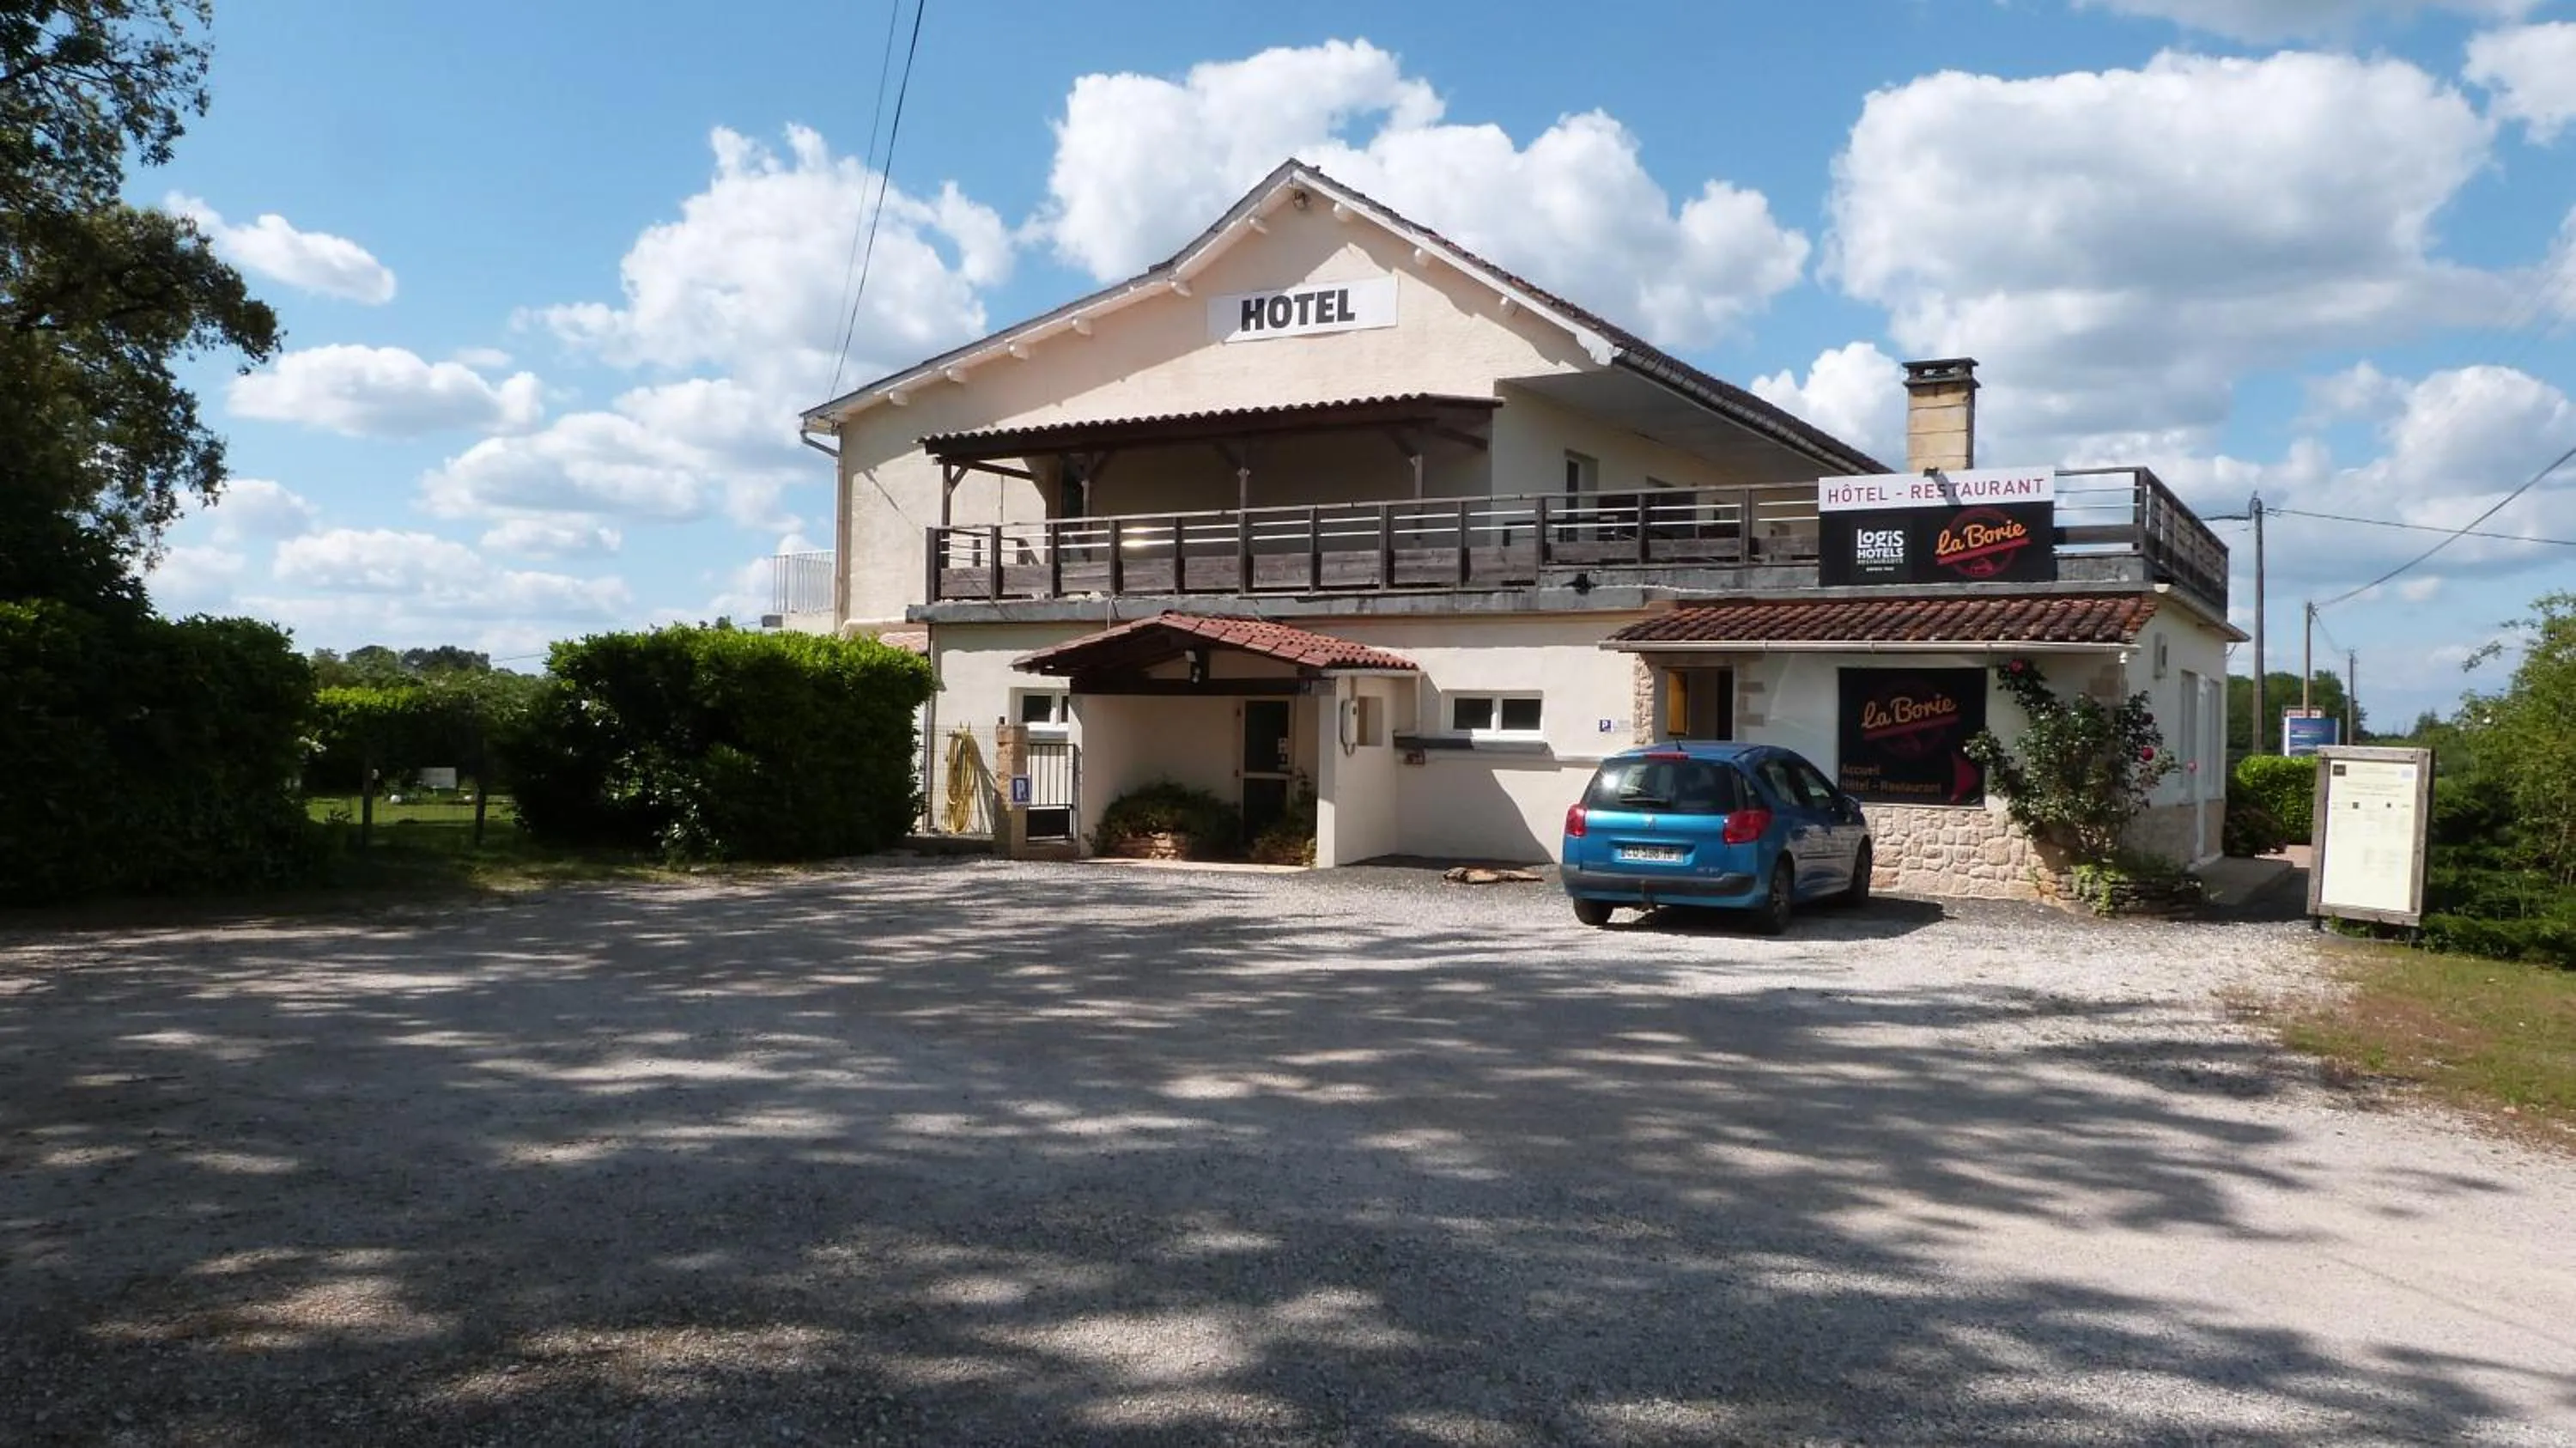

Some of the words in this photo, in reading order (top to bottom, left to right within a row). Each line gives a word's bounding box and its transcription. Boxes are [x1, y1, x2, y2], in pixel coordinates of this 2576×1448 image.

[1241, 289, 1356, 332] HOTEL
[1827, 484, 1888, 503] HÔTEL
[1911, 478, 2044, 499] RESTAURANT
[1962, 519, 2026, 548] Borie
[1856, 547, 1904, 559] HOTELS
[1890, 692, 1957, 723] Borie
